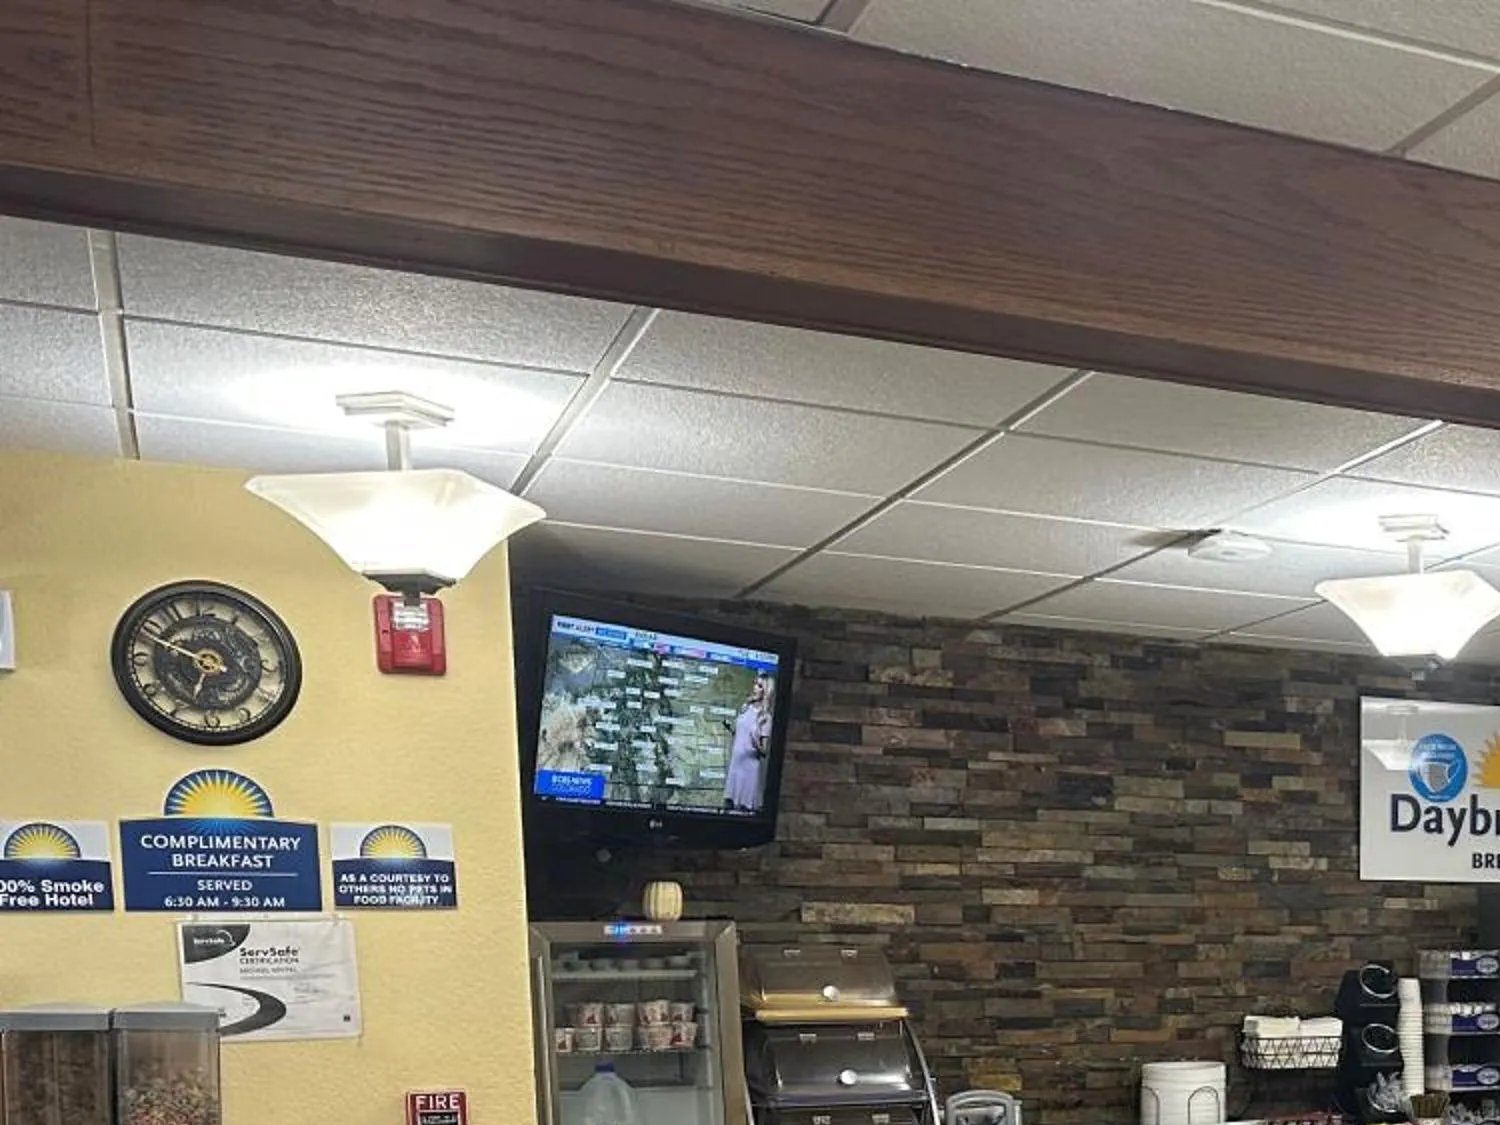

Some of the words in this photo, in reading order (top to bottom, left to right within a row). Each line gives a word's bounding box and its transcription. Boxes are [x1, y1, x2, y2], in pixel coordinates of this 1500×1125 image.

[141, 834, 301, 850] COMPLIMENTARY
[172, 853, 274, 868] BREAKFAST
[341, 873, 356, 883] AS
[360, 874, 367, 882] A
[370, 873, 430, 883] COURTESY
[434, 874, 449, 883] TO
[41, 879, 104, 893] Smoke
[197, 879, 253, 891] SERVED
[339, 884, 386, 894] OTHERS
[389, 885, 406, 894] NO
[0, 893, 40, 907] Free
[45, 893, 94, 907] Hotel
[164, 896, 193, 907] 6:30
[200, 897, 219, 907] AM
[231, 897, 260, 907] 9:30
[263, 897, 285, 907] AM
[353, 895, 387, 905] FOOD
[389, 895, 439, 905] FACILITY
[240, 946, 299, 957] ServSafe
[416, 1094, 460, 1109] FIRE
